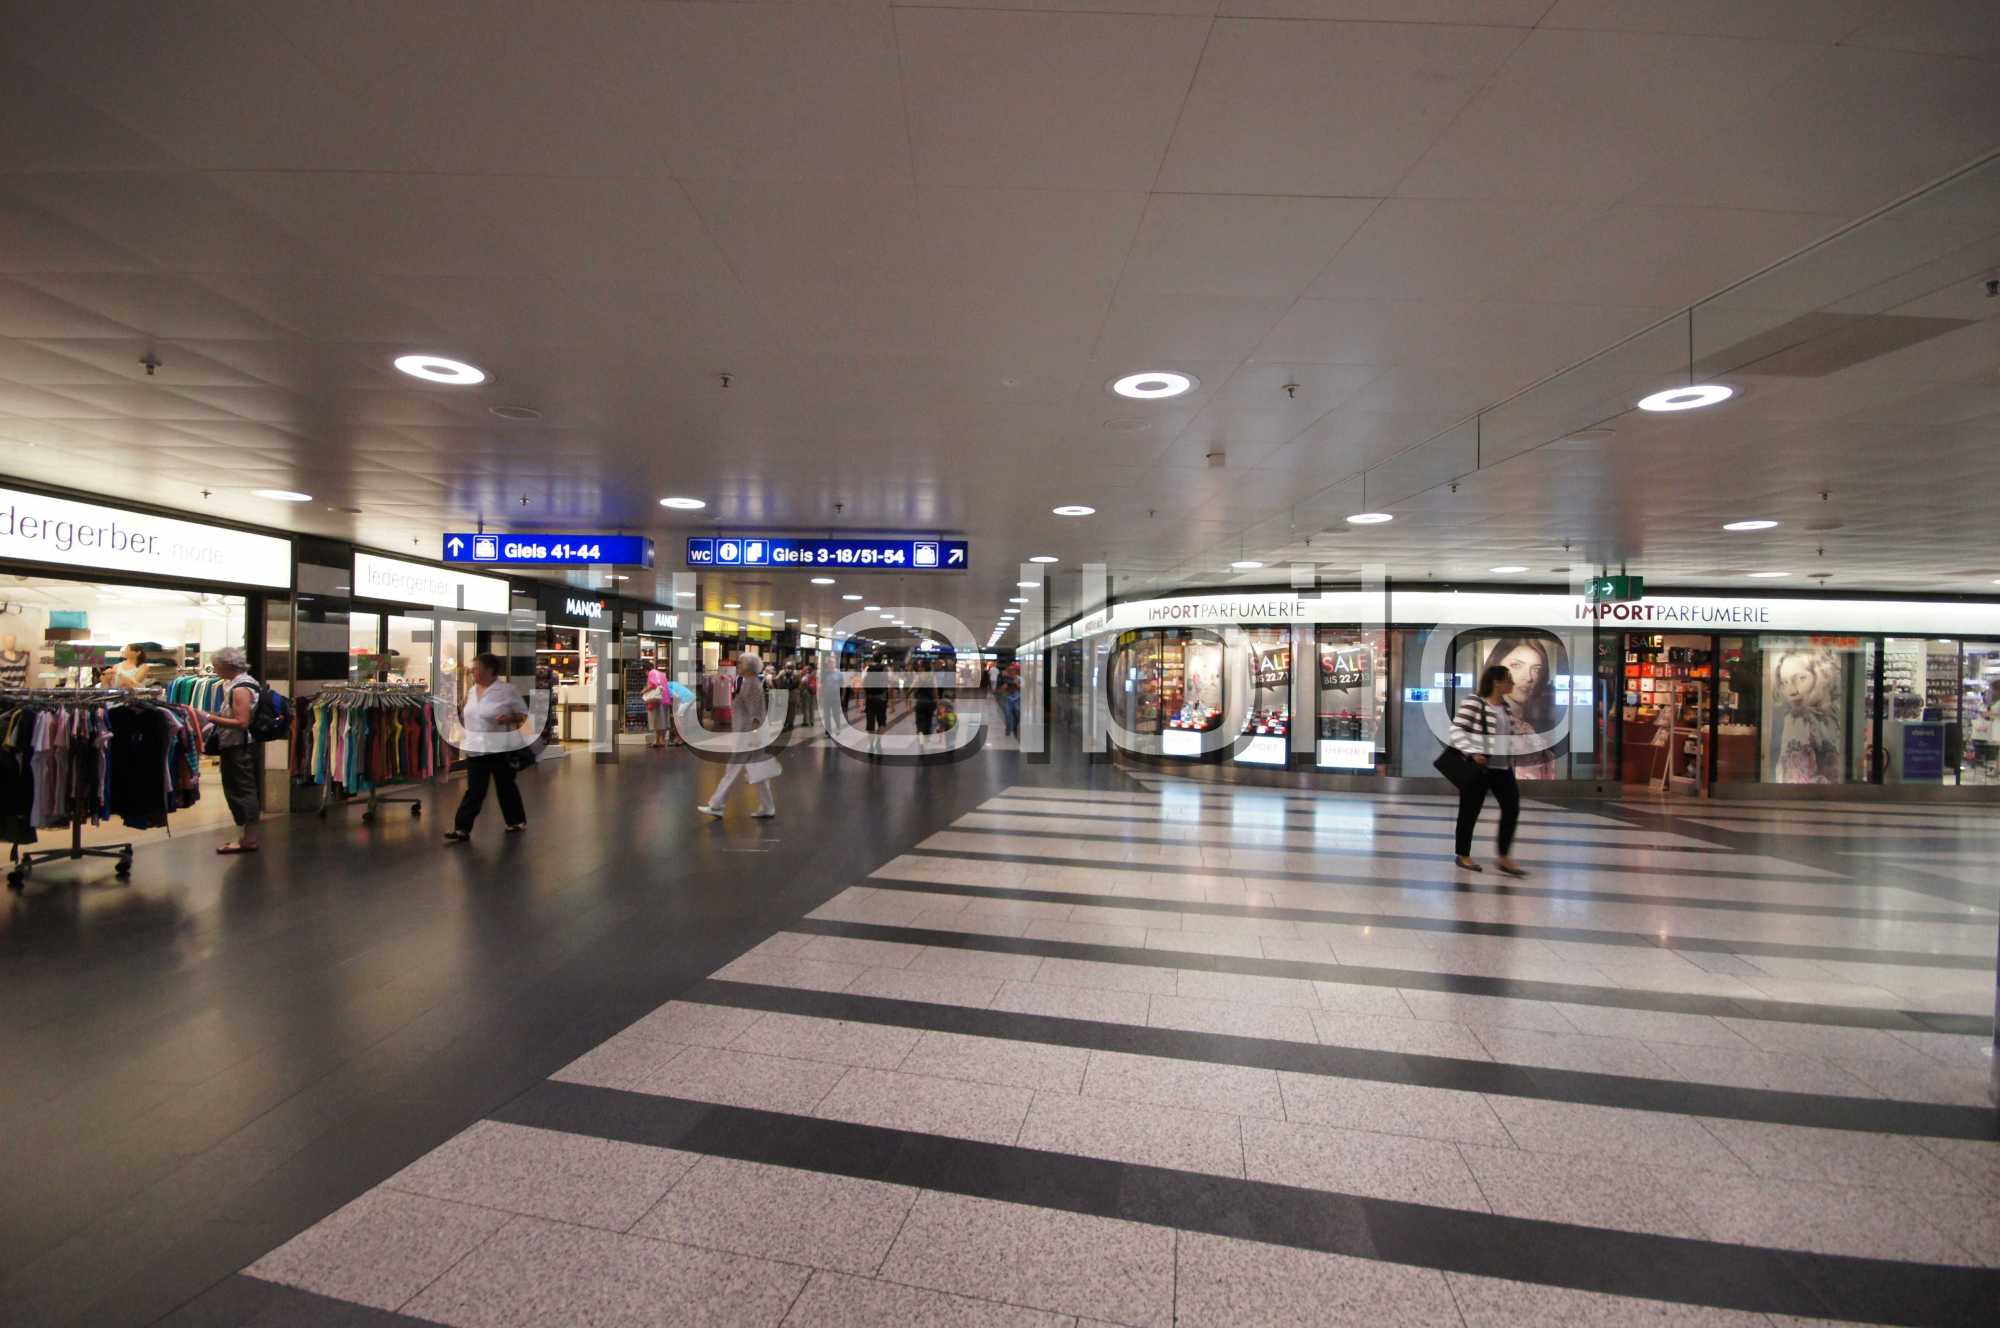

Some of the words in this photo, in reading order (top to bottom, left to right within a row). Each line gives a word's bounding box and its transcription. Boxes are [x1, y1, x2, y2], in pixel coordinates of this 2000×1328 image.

[504, 543, 547, 559] Gleis
[551, 544, 600, 559] 41-44
[691, 550, 711, 561] WC
[773, 548, 813, 563] Gleis
[817, 549, 906, 564] 3-18/51-54
[566, 598, 602, 619] MANOR
[655, 612, 678, 628] MANOR
[1631, 634, 1664, 649] SALE
[1322, 653, 1369, 673] SALE
